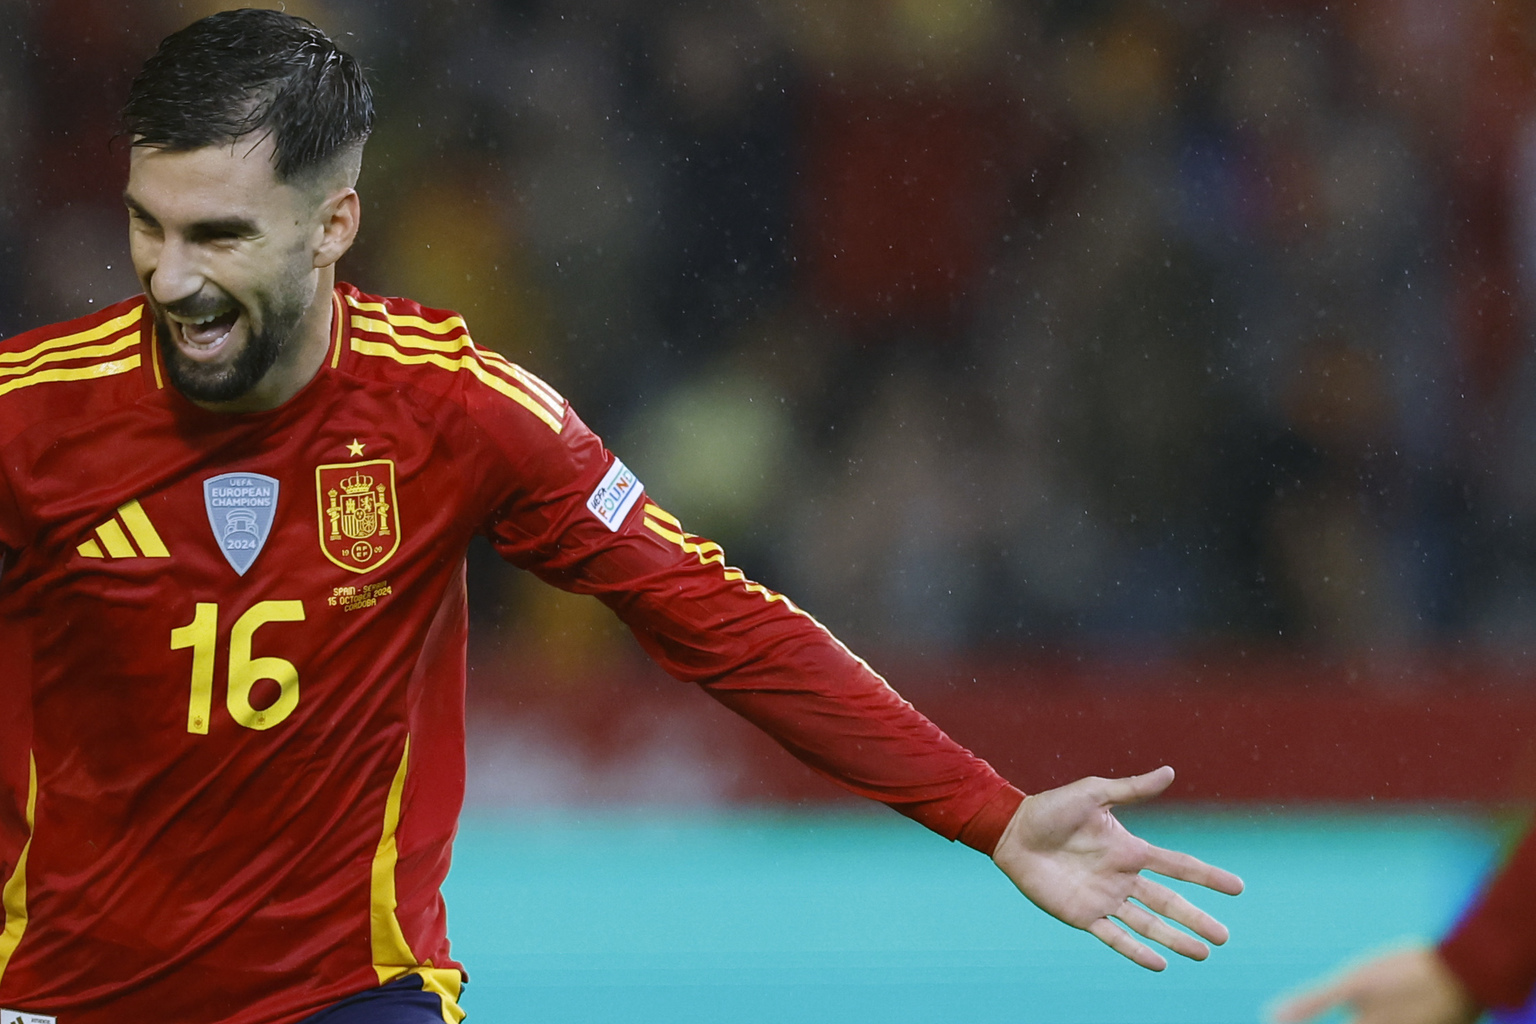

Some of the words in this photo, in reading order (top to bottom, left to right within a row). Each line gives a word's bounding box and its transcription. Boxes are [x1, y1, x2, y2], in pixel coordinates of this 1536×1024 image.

[211, 487, 271, 498] EUROPEAN
[211, 498, 271, 508] CHAMPIONS
[227, 540, 256, 550] 2024
[327, 597, 338, 607] 15
[373, 585, 393, 598] 2024
[170, 599, 306, 736] 16
